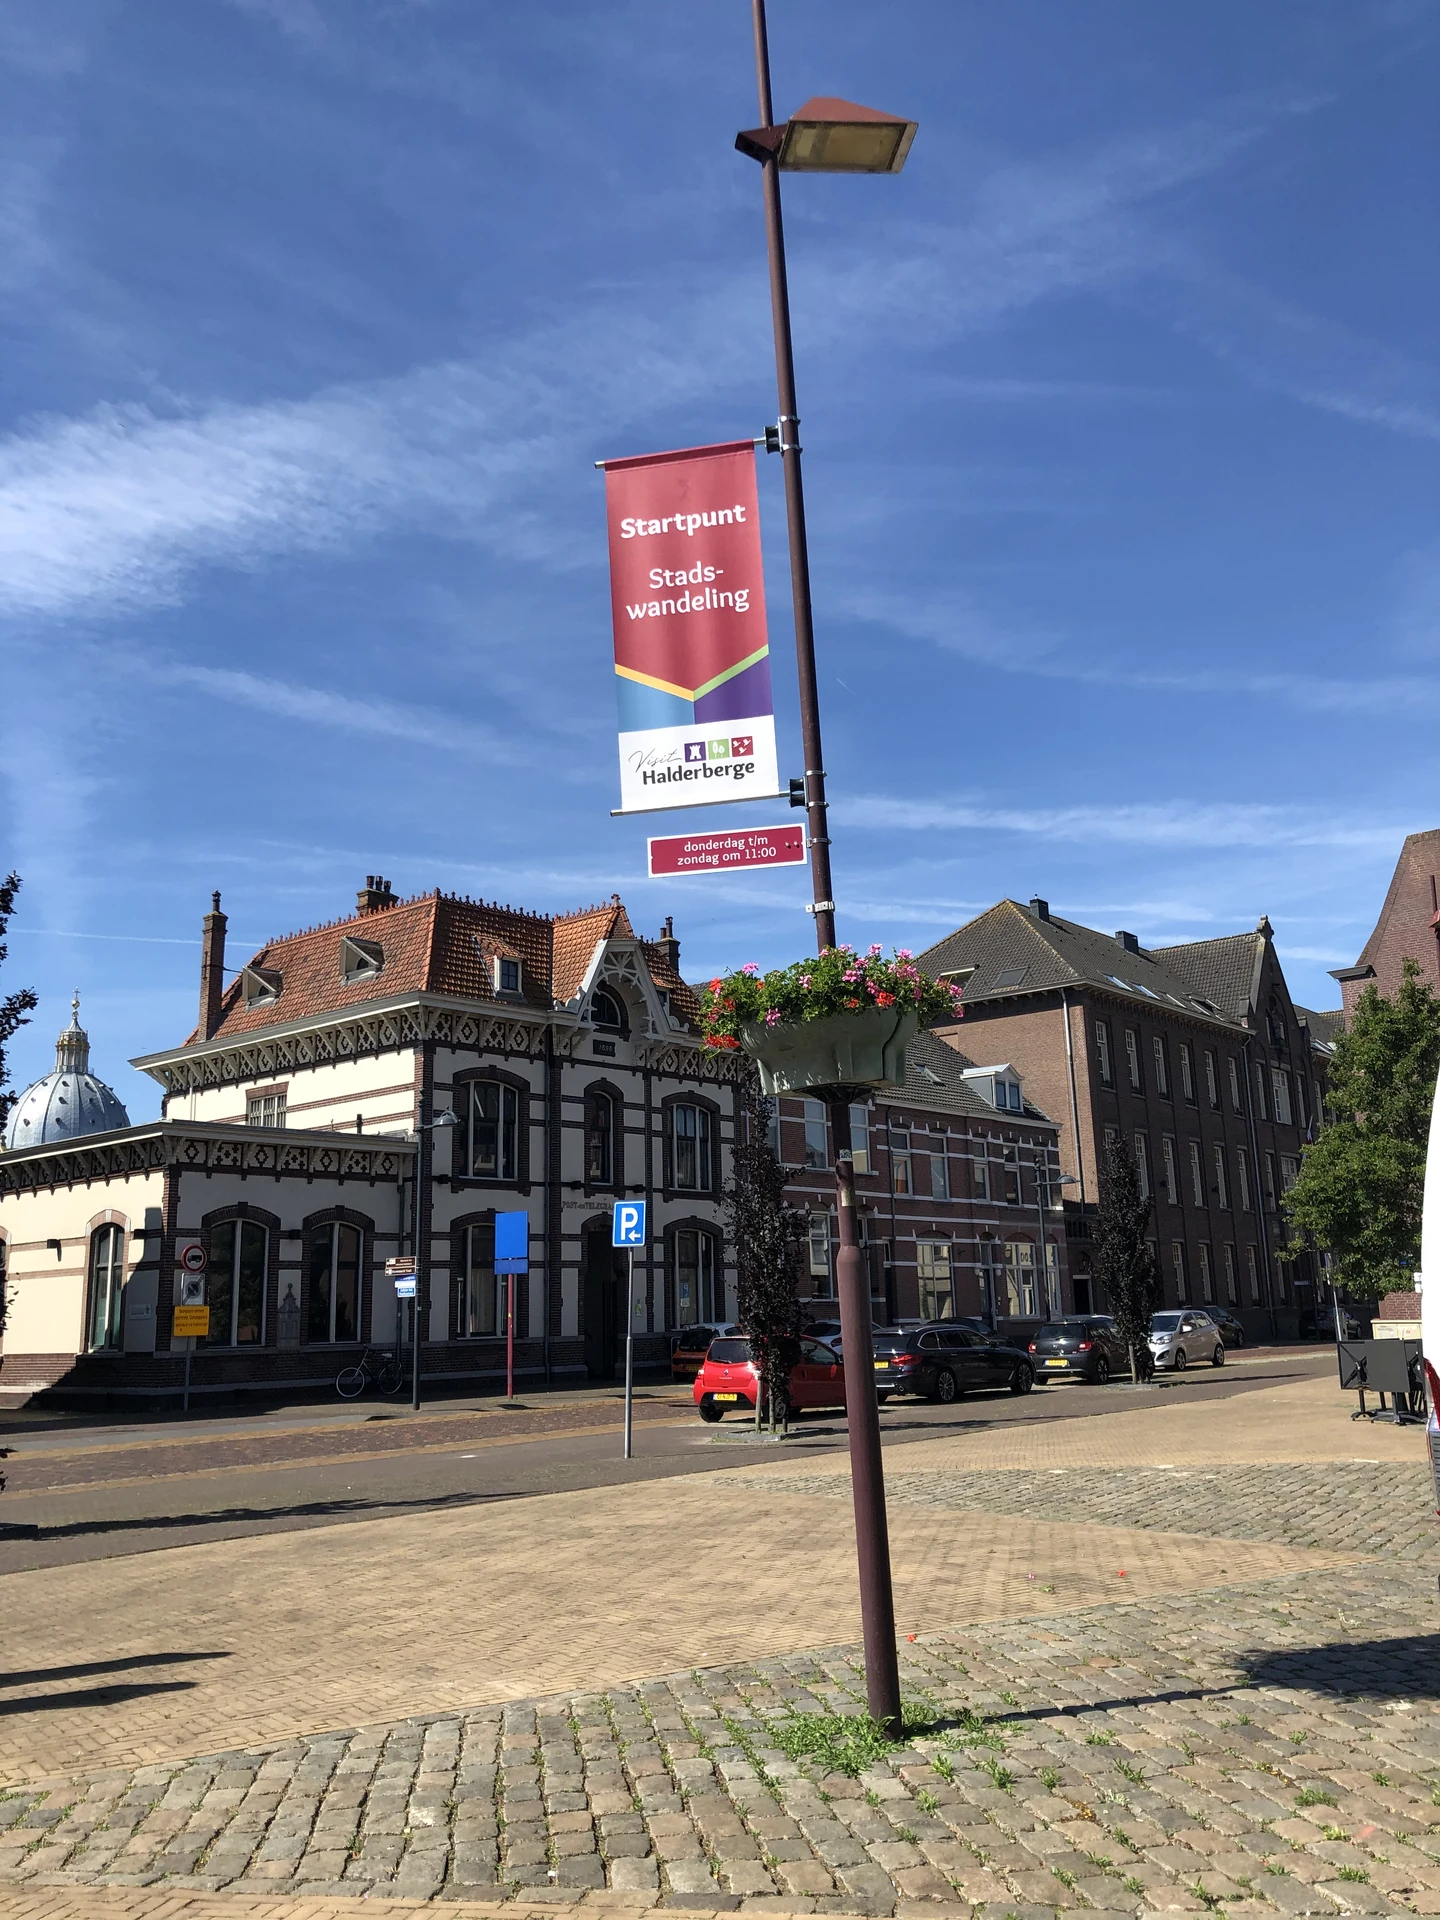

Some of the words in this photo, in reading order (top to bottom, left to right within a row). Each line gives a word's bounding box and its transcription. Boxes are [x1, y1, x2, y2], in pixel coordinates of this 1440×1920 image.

[620, 504, 747, 539] Startpunt
[649, 560, 724, 589] Stads-
[625, 587, 750, 620] wandeling
[628, 748, 683, 773] Visit
[642, 761, 755, 786] Halderberge
[677, 851, 719, 866] zondag
[722, 852, 741, 862] om
[745, 846, 777, 860] 11:00
[684, 836, 745, 852] donderdag
[748, 835, 769, 847] t/m
[620, 1207, 639, 1241] P
